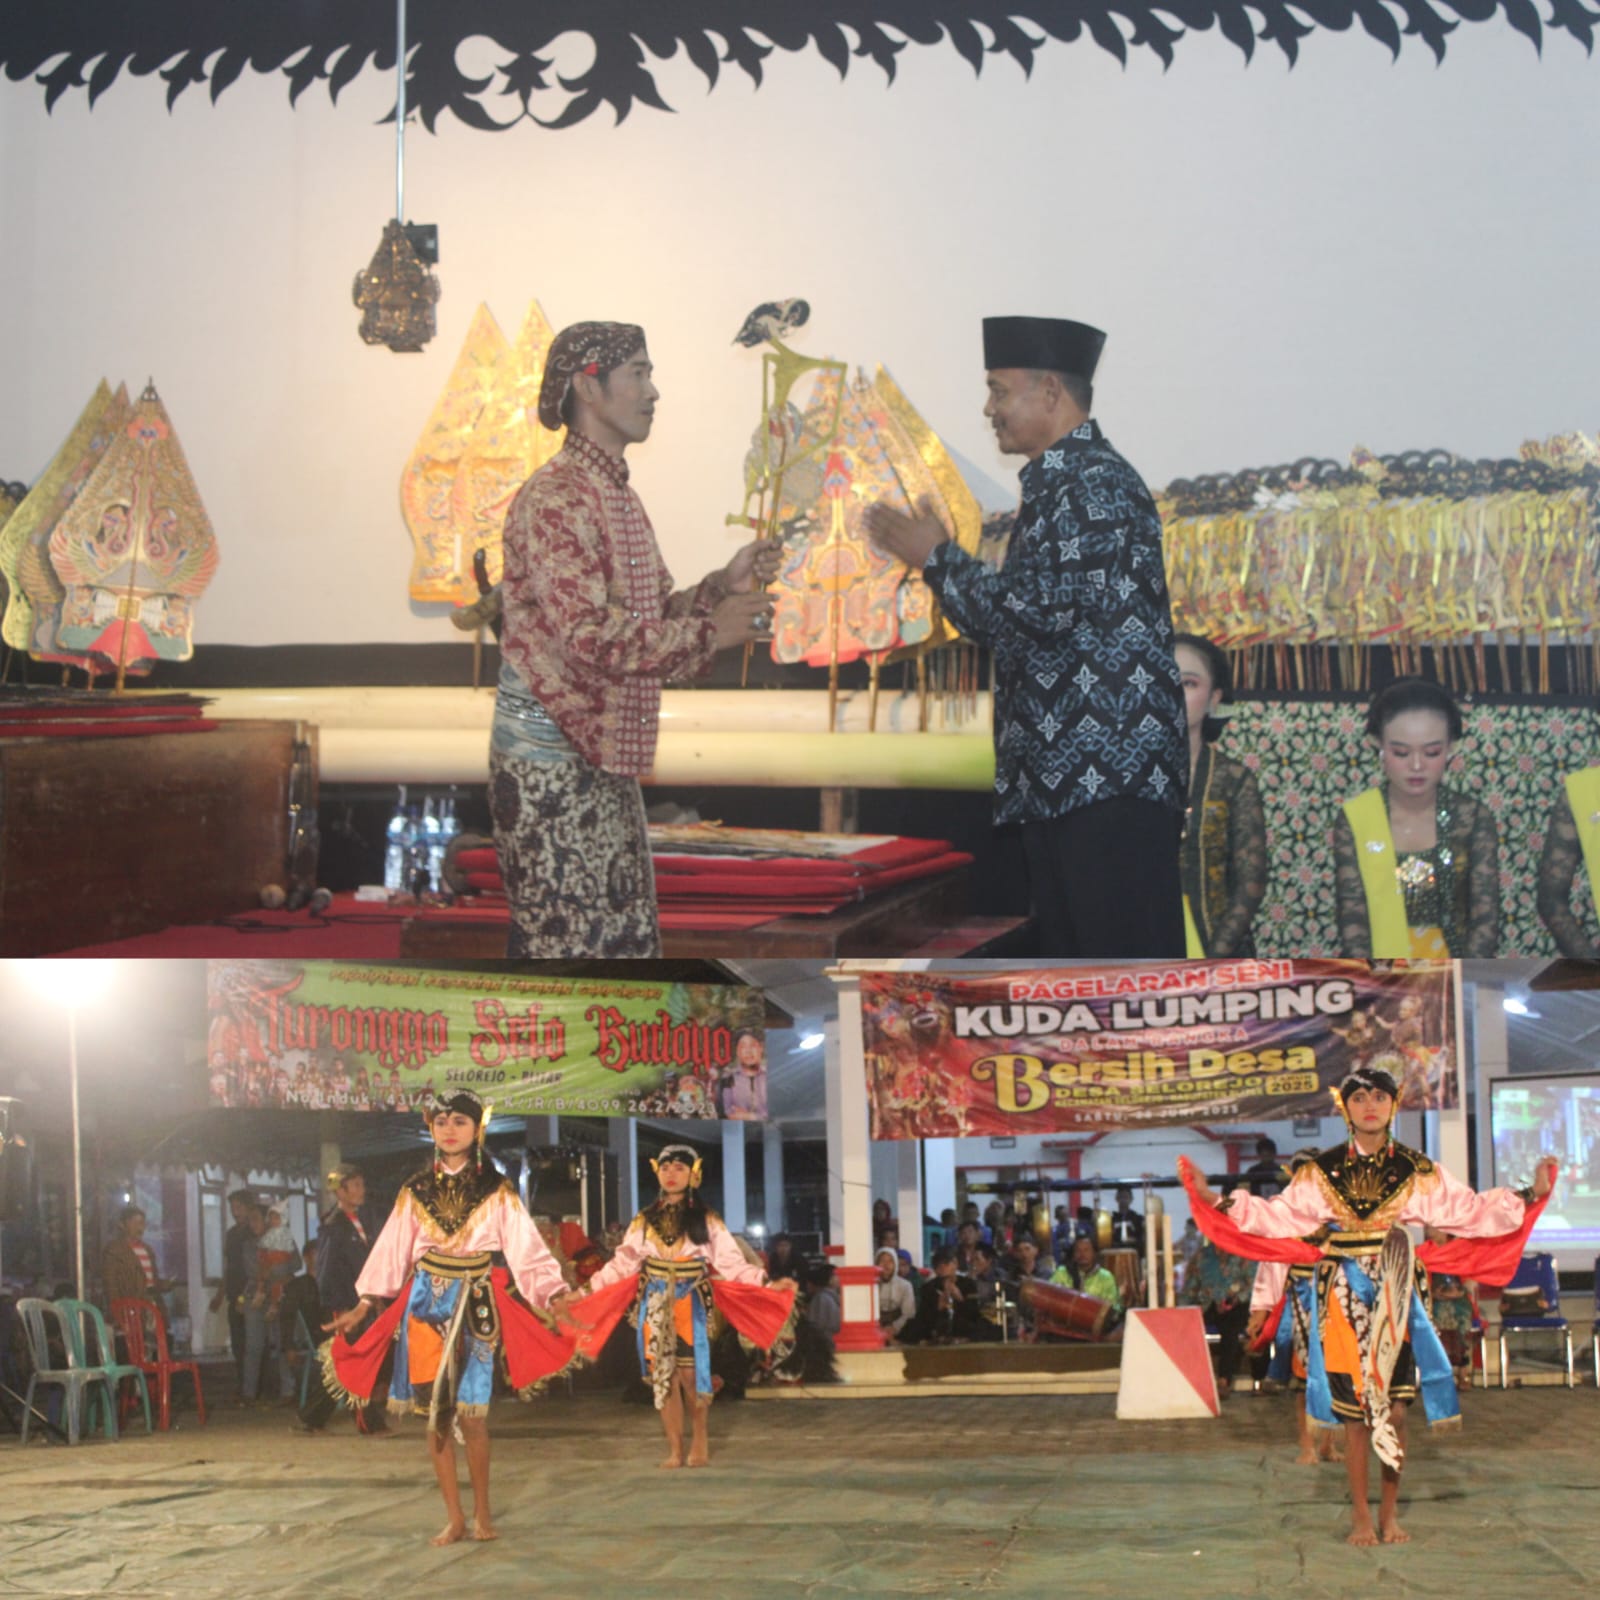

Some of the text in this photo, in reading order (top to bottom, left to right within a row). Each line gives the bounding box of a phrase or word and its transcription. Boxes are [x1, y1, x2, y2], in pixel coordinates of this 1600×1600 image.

[1010, 959, 1293, 1001] PAGELARAN SENI
[954, 979, 1354, 1038] KUDA LUMPING
[469, 999, 566, 1067] Selo
[585, 1004, 732, 1076] Budoyo
[1060, 1028, 1249, 1051] DALAM RANGKA
[445, 1068, 506, 1083] SELOREJO
[970, 1051, 1176, 1113] Bersih
[1189, 1046, 1316, 1078] Desa
[1271, 1080, 1314, 1092] 2025
[1055, 1086, 1121, 1099] DESA
[1203, 1104, 1240, 1117] 2025
